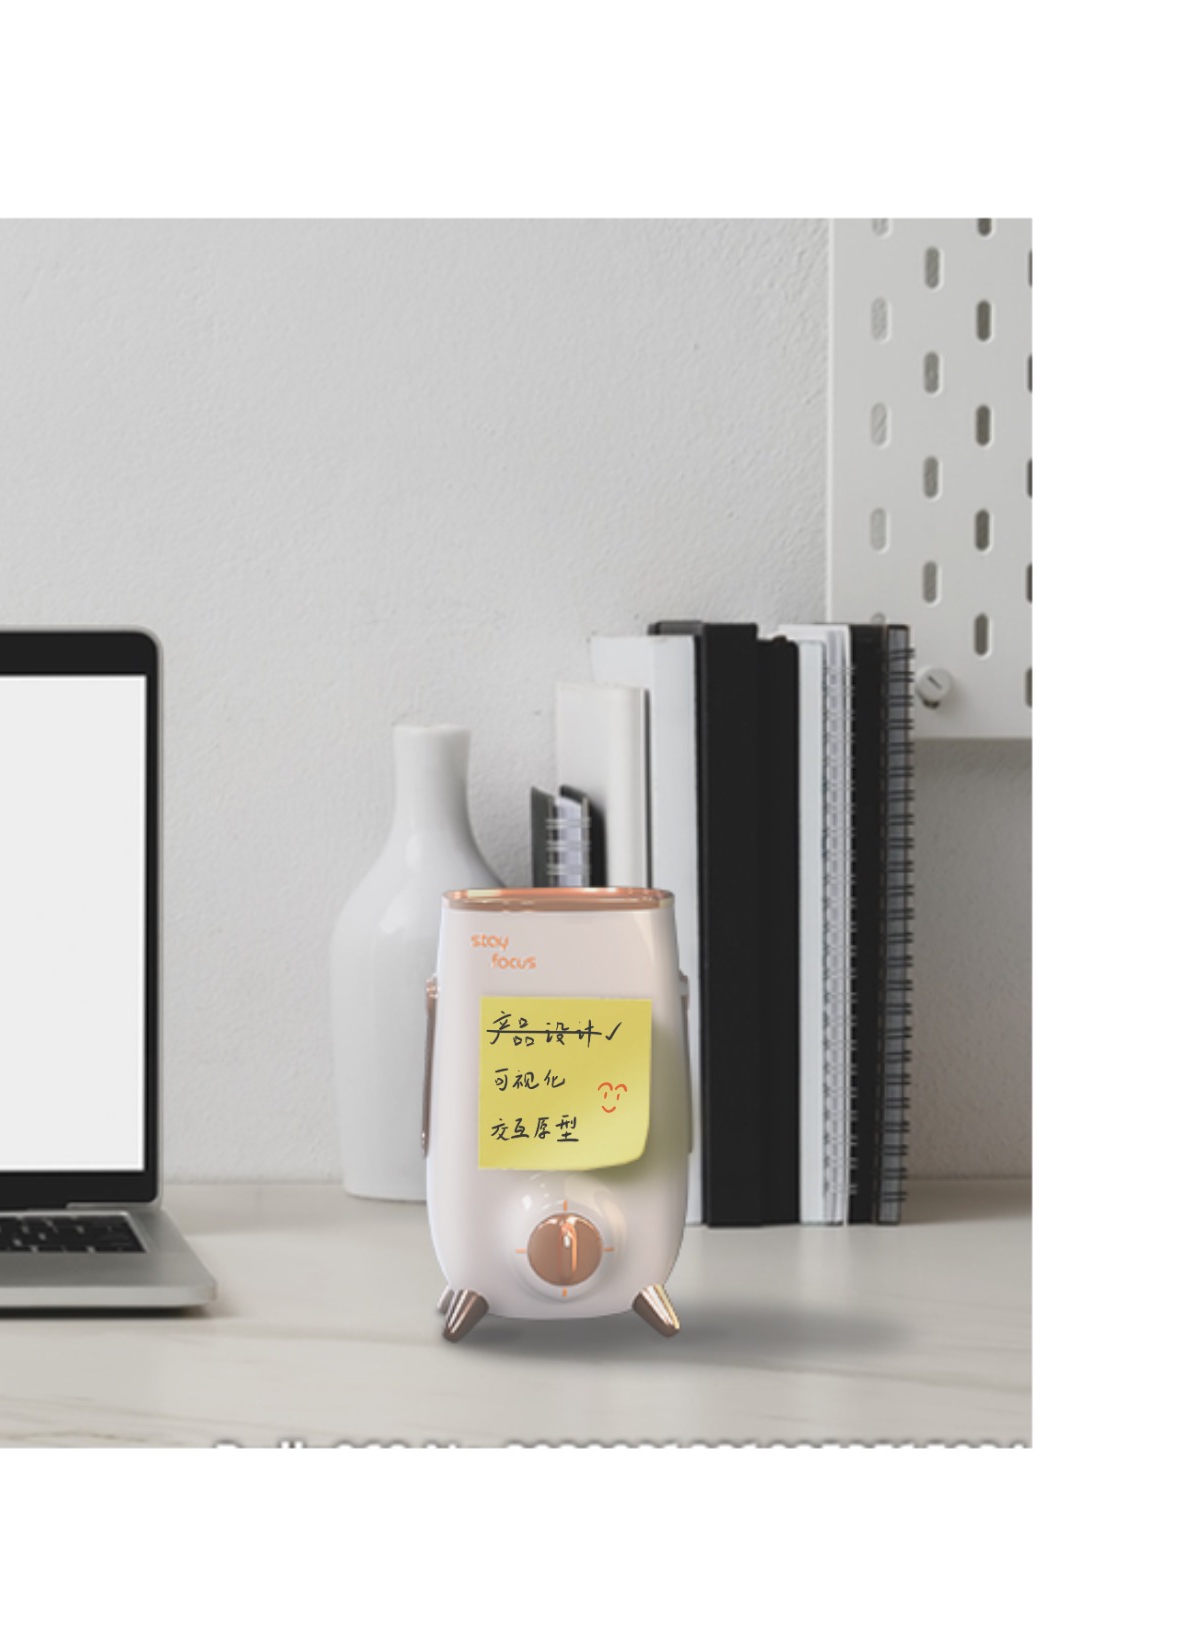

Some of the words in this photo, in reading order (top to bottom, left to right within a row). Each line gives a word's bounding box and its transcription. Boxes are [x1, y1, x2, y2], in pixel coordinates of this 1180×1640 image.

[470, 933, 509, 951] stay
[491, 952, 537, 969] focus
[488, 1010, 596, 1048] 产品设计
[494, 1068, 566, 1092] 可视化
[490, 1114, 579, 1142] 交互原型
